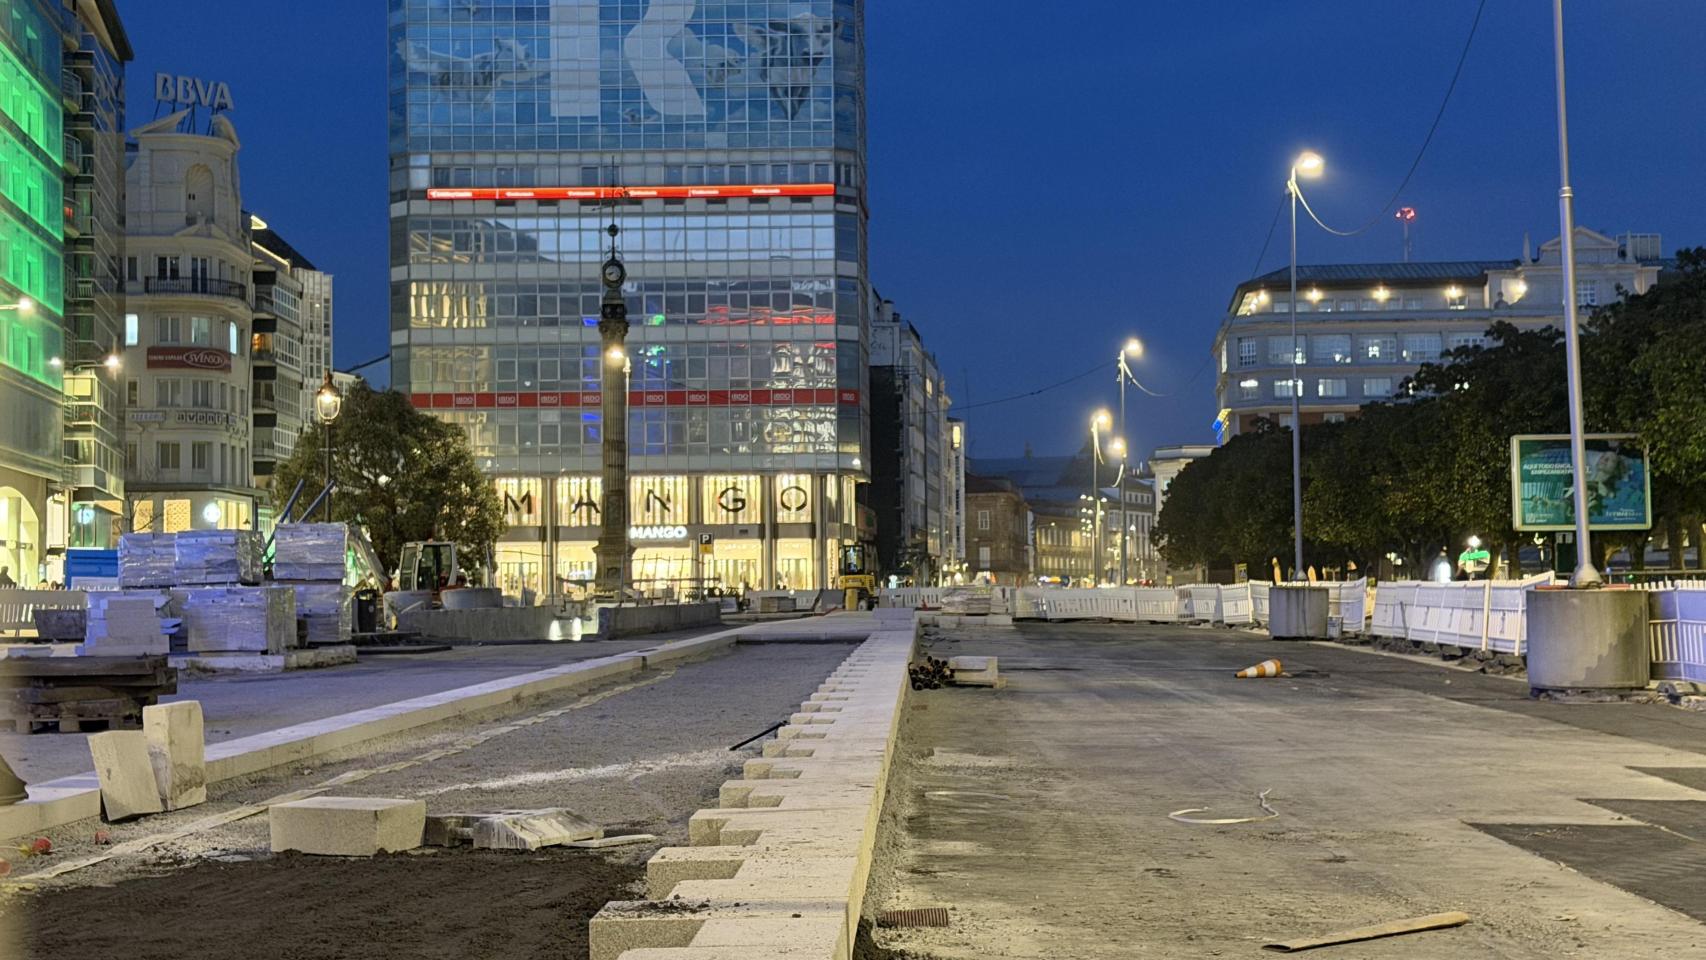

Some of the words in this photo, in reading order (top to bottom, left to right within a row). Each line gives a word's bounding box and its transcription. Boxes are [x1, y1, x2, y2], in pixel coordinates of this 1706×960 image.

[156, 73, 234, 112] BBVA
[504, 486, 808, 513] MANGO
[629, 526, 687, 539] MANGO
